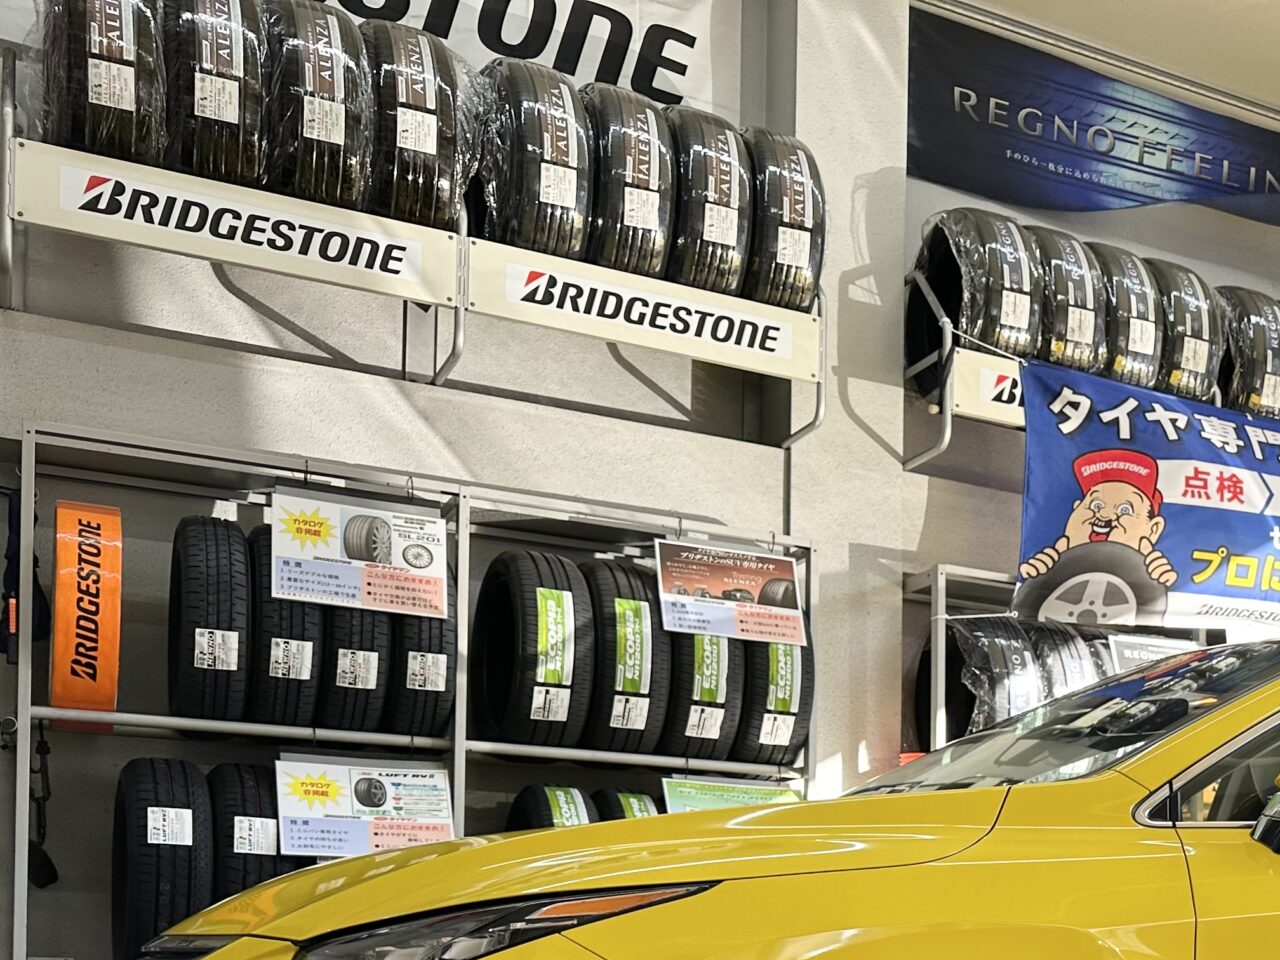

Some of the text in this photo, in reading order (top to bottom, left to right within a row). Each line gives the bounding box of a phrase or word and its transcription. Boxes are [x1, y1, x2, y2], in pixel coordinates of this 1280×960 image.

[315, 19, 333, 82] ALENZA
[953, 86, 1115, 156] REGNO
[78, 174, 407, 276] BRIDGESTONE
[519, 269, 781, 353] BRIDGESTONE
[1264, 306, 1279, 348] REGNO
[1080, 460, 1151, 479] BRIDGESTONE
[1181, 468, 1247, 505] 点検
[292, 517, 324, 529] カタログ
[70, 518, 103, 684] BRIDGESTONE
[300, 782, 331, 790] カタログ
